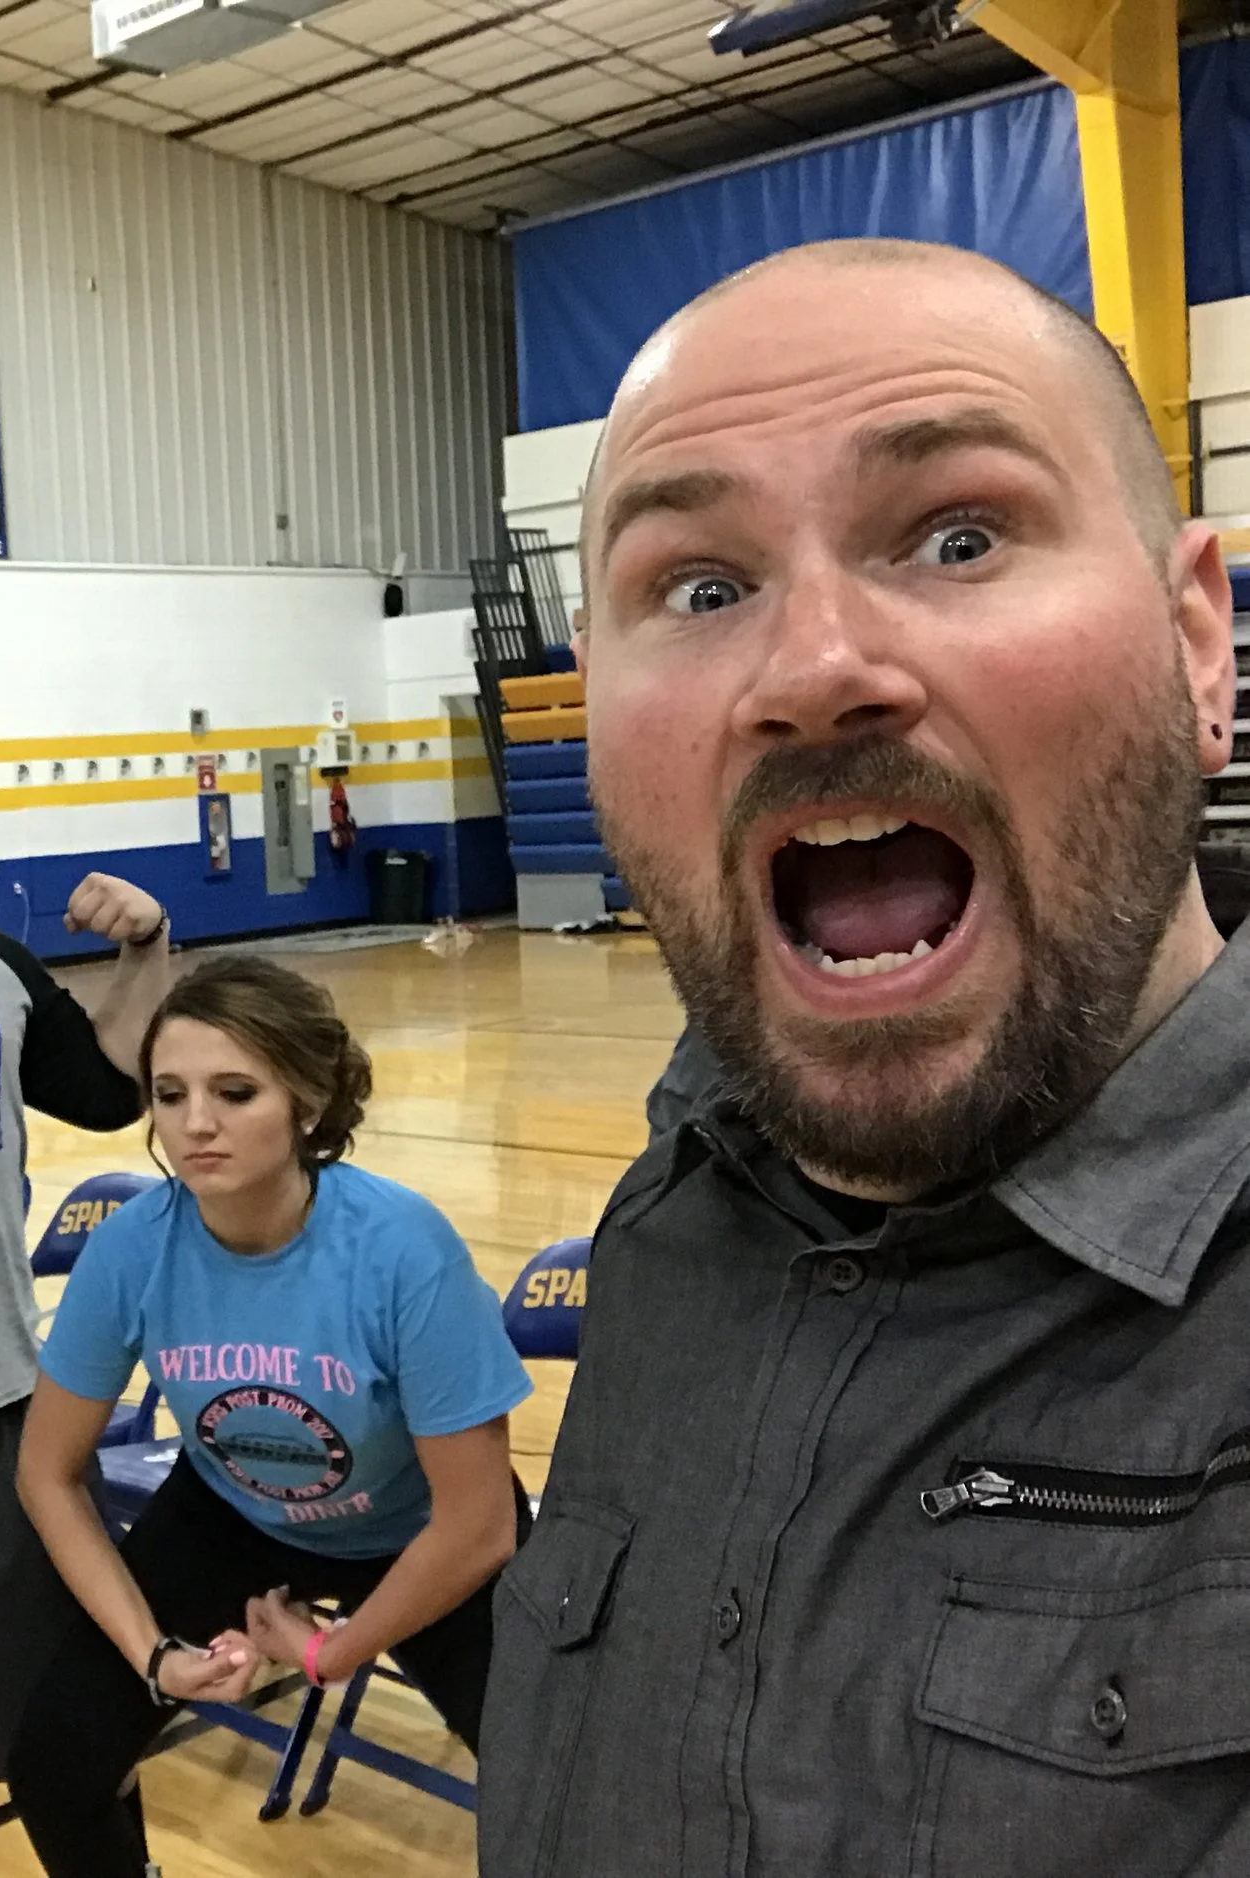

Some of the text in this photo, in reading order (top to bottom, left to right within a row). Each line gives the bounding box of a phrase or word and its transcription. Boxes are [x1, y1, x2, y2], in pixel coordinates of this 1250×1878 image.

[523, 1268, 587, 1308] SPA
[159, 1343, 356, 1397] WELCOME TO
